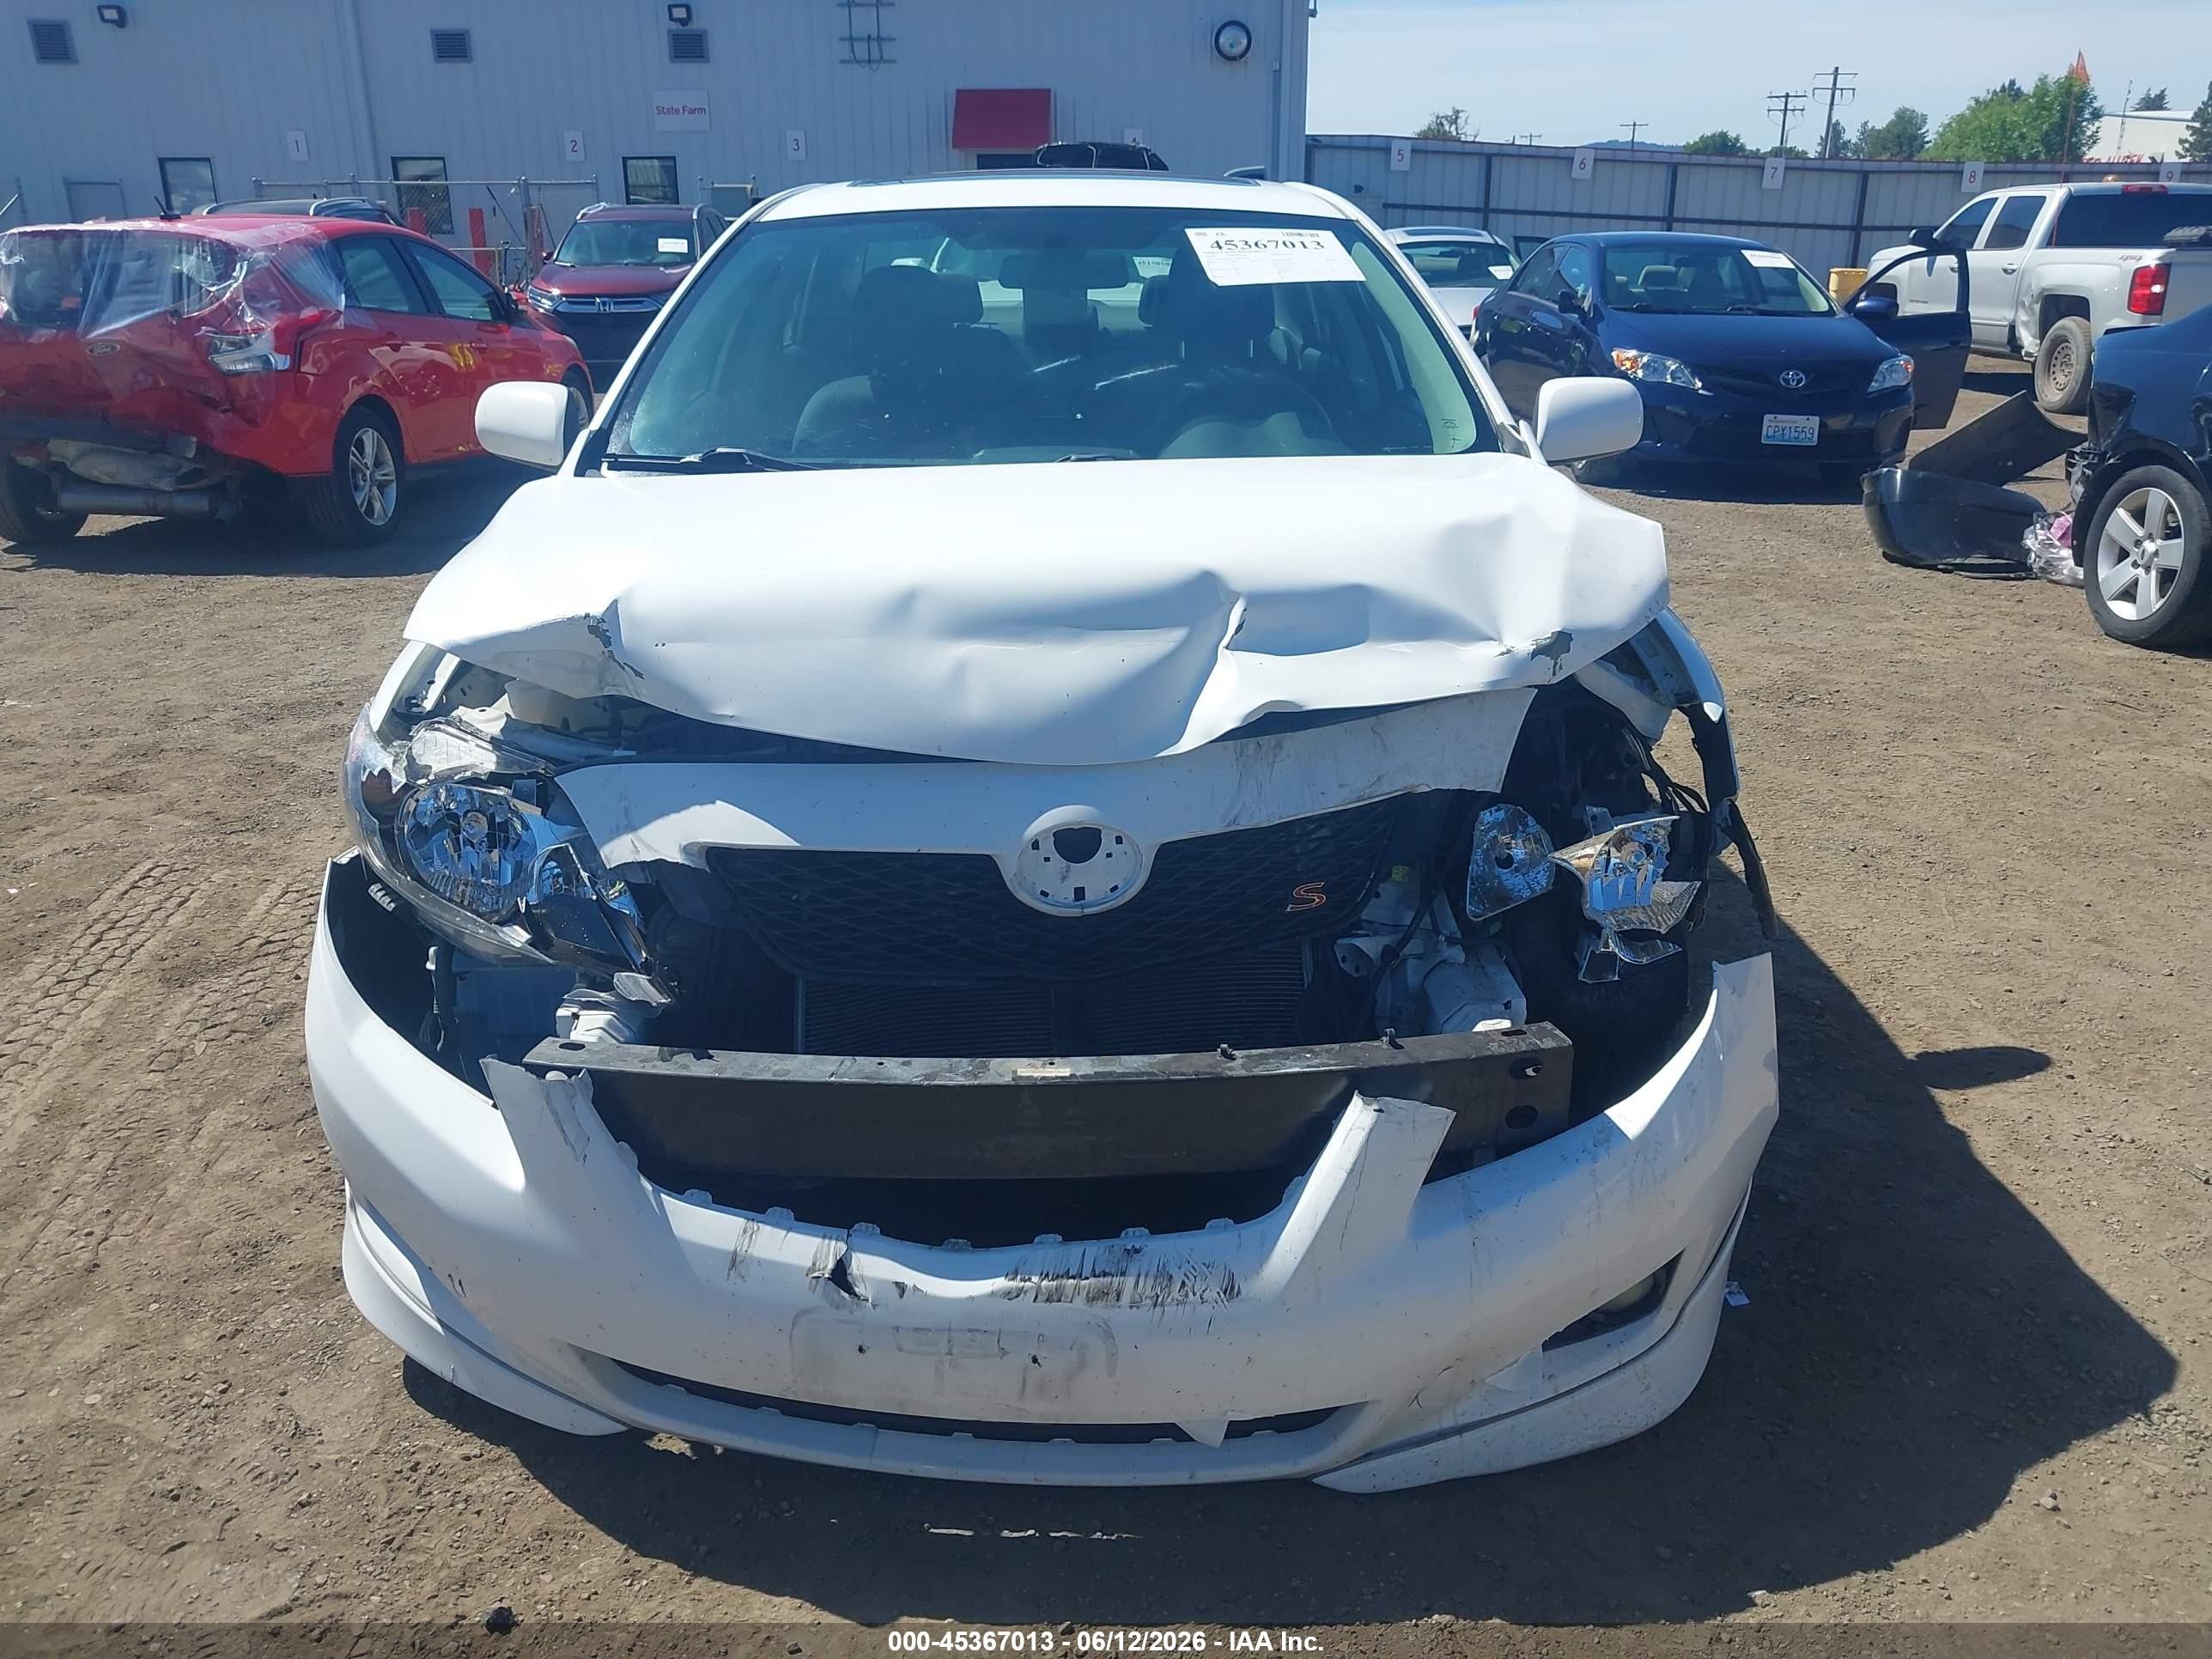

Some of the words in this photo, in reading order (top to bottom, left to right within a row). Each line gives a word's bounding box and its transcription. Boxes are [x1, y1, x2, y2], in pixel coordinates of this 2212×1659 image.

[655, 105, 681, 116] State
[682, 105, 707, 115] Farm
[569, 139, 579, 153] 2
[792, 138, 800, 151] 3
[1396, 149, 1405, 161] 5
[1578, 157, 1587, 170] 6
[1771, 167, 1779, 179] 7
[1968, 170, 1977, 184] 8
[2166, 171, 2174, 182] 9
[1210, 240, 1325, 251] 45367013
[1765, 425, 1814, 441] CPY1559
[1285, 882, 1326, 912] S
